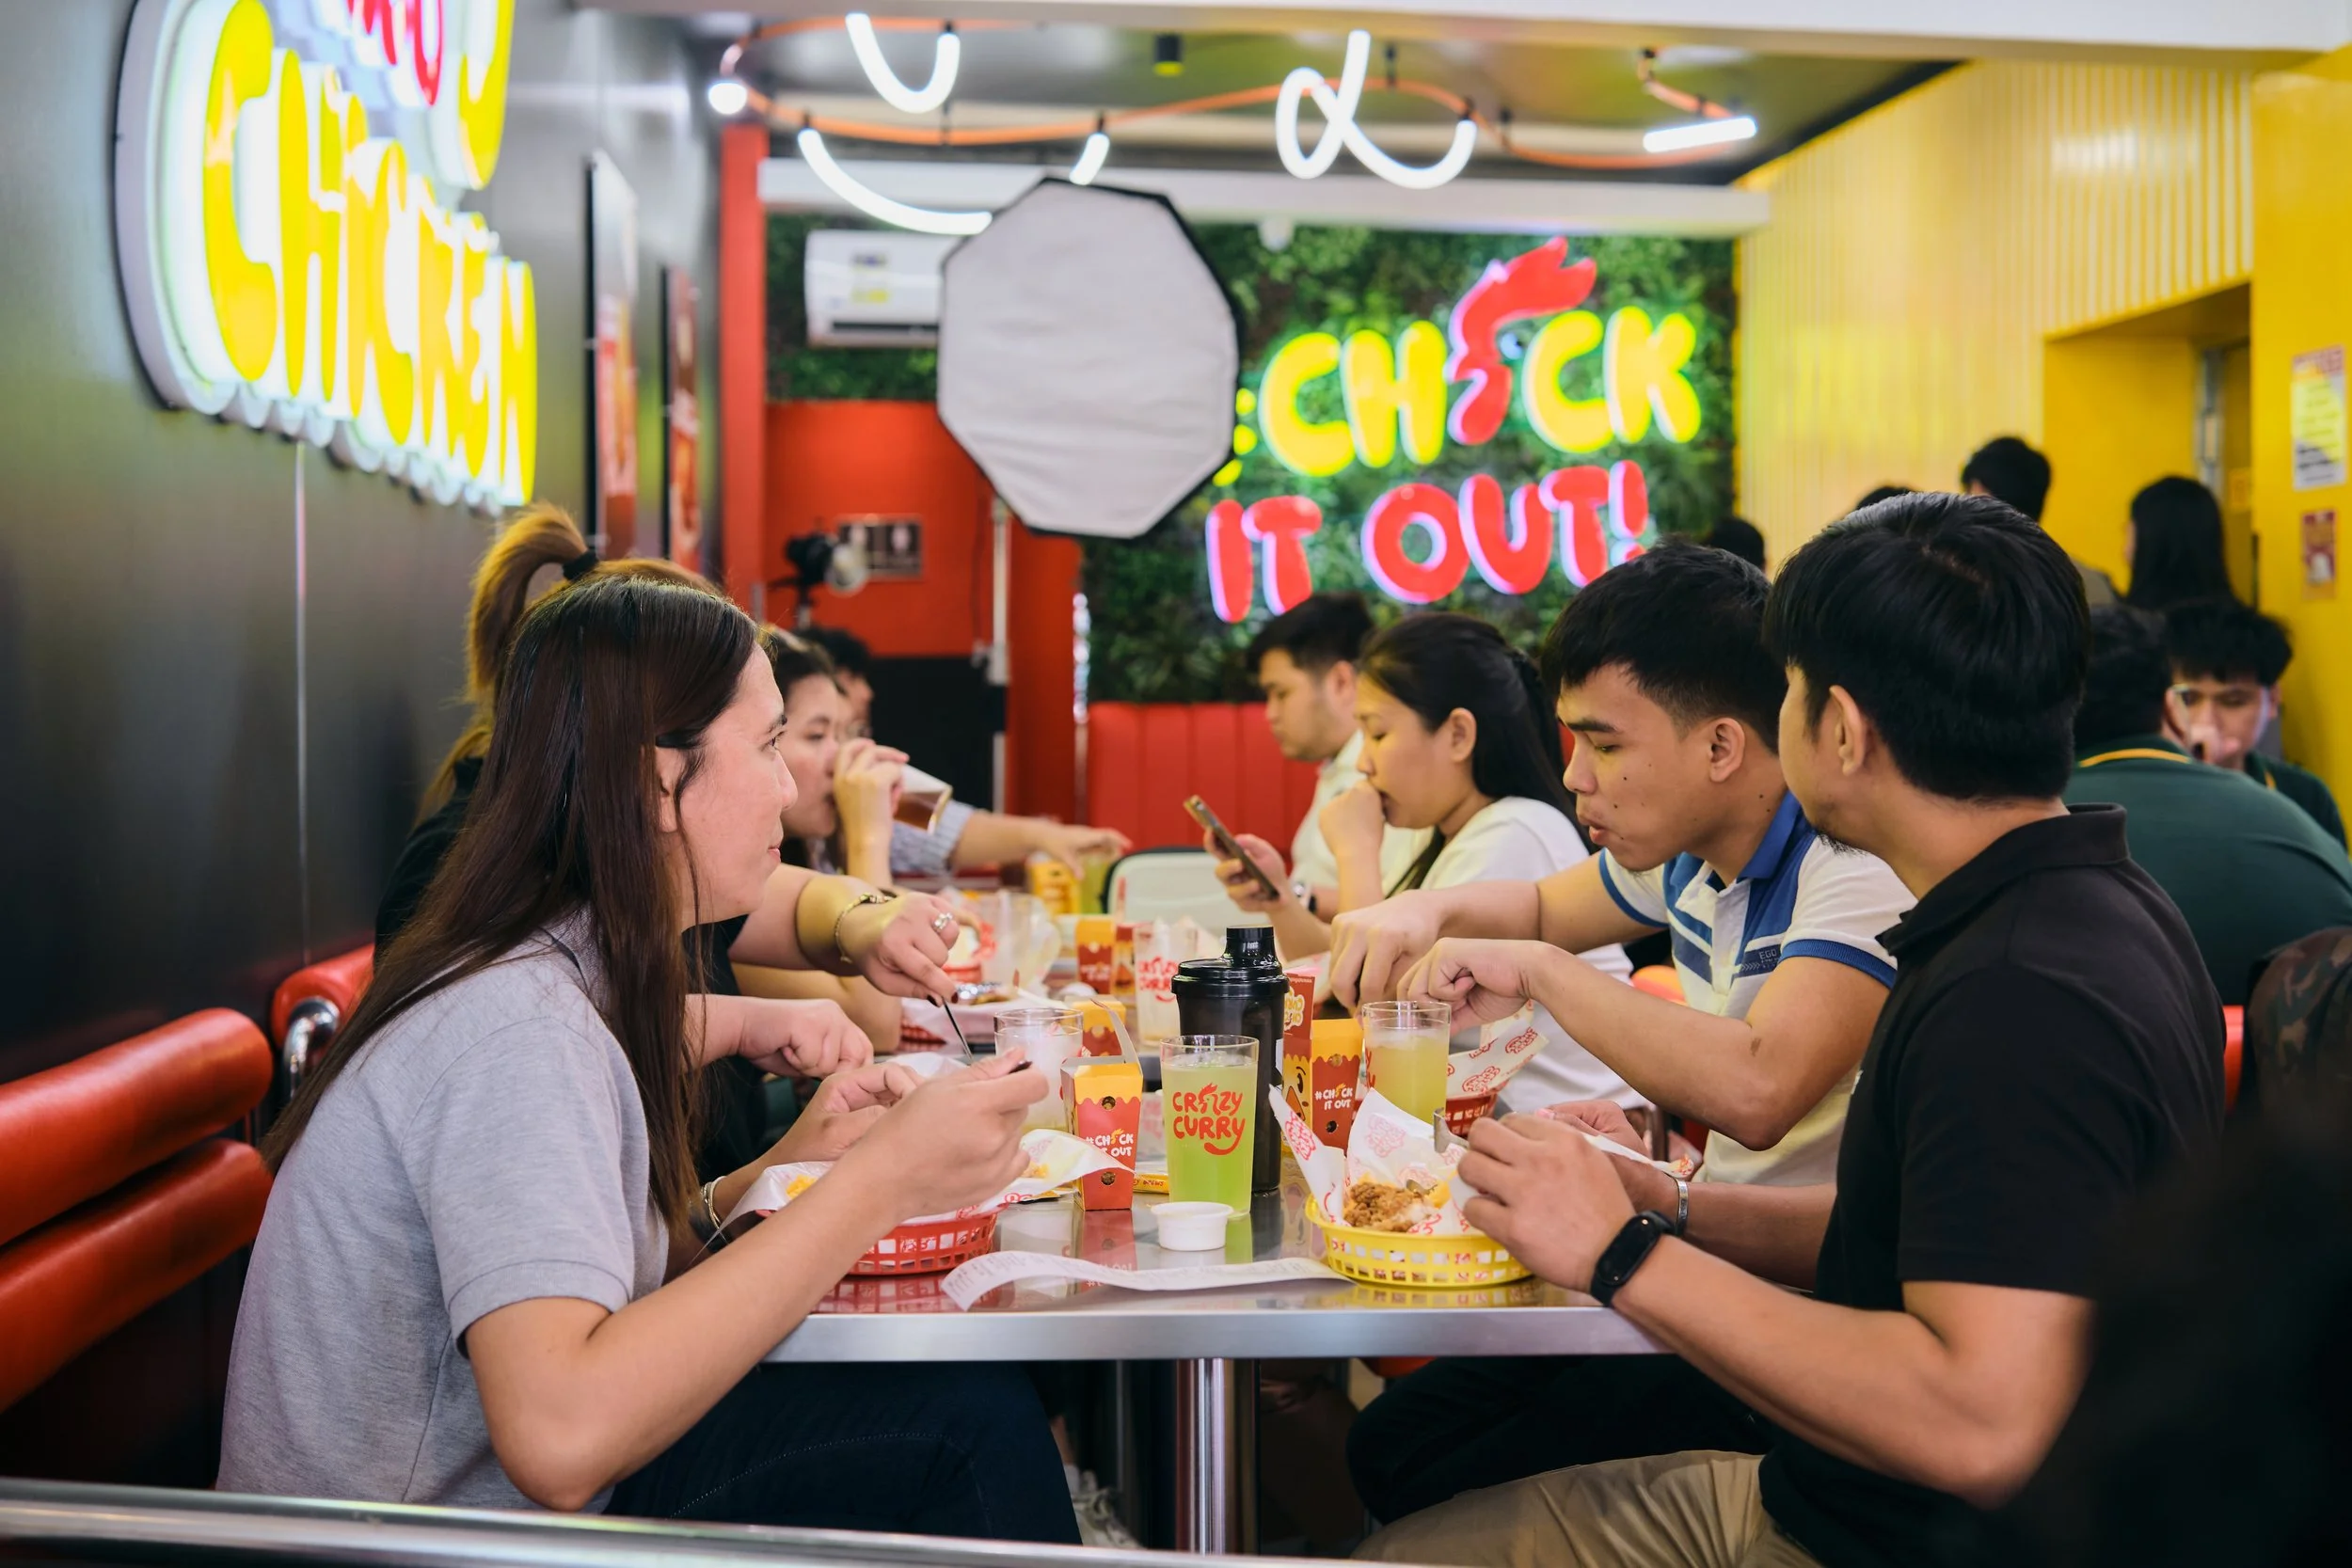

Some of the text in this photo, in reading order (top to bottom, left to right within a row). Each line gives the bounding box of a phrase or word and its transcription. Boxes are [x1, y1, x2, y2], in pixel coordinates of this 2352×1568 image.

[1205, 459, 1649, 623] IT OUT!
[1324, 1099, 1352, 1111] IT OUT
[1173, 1116, 1246, 1156] CURRY
[1110, 1146, 1133, 1158] OUT
